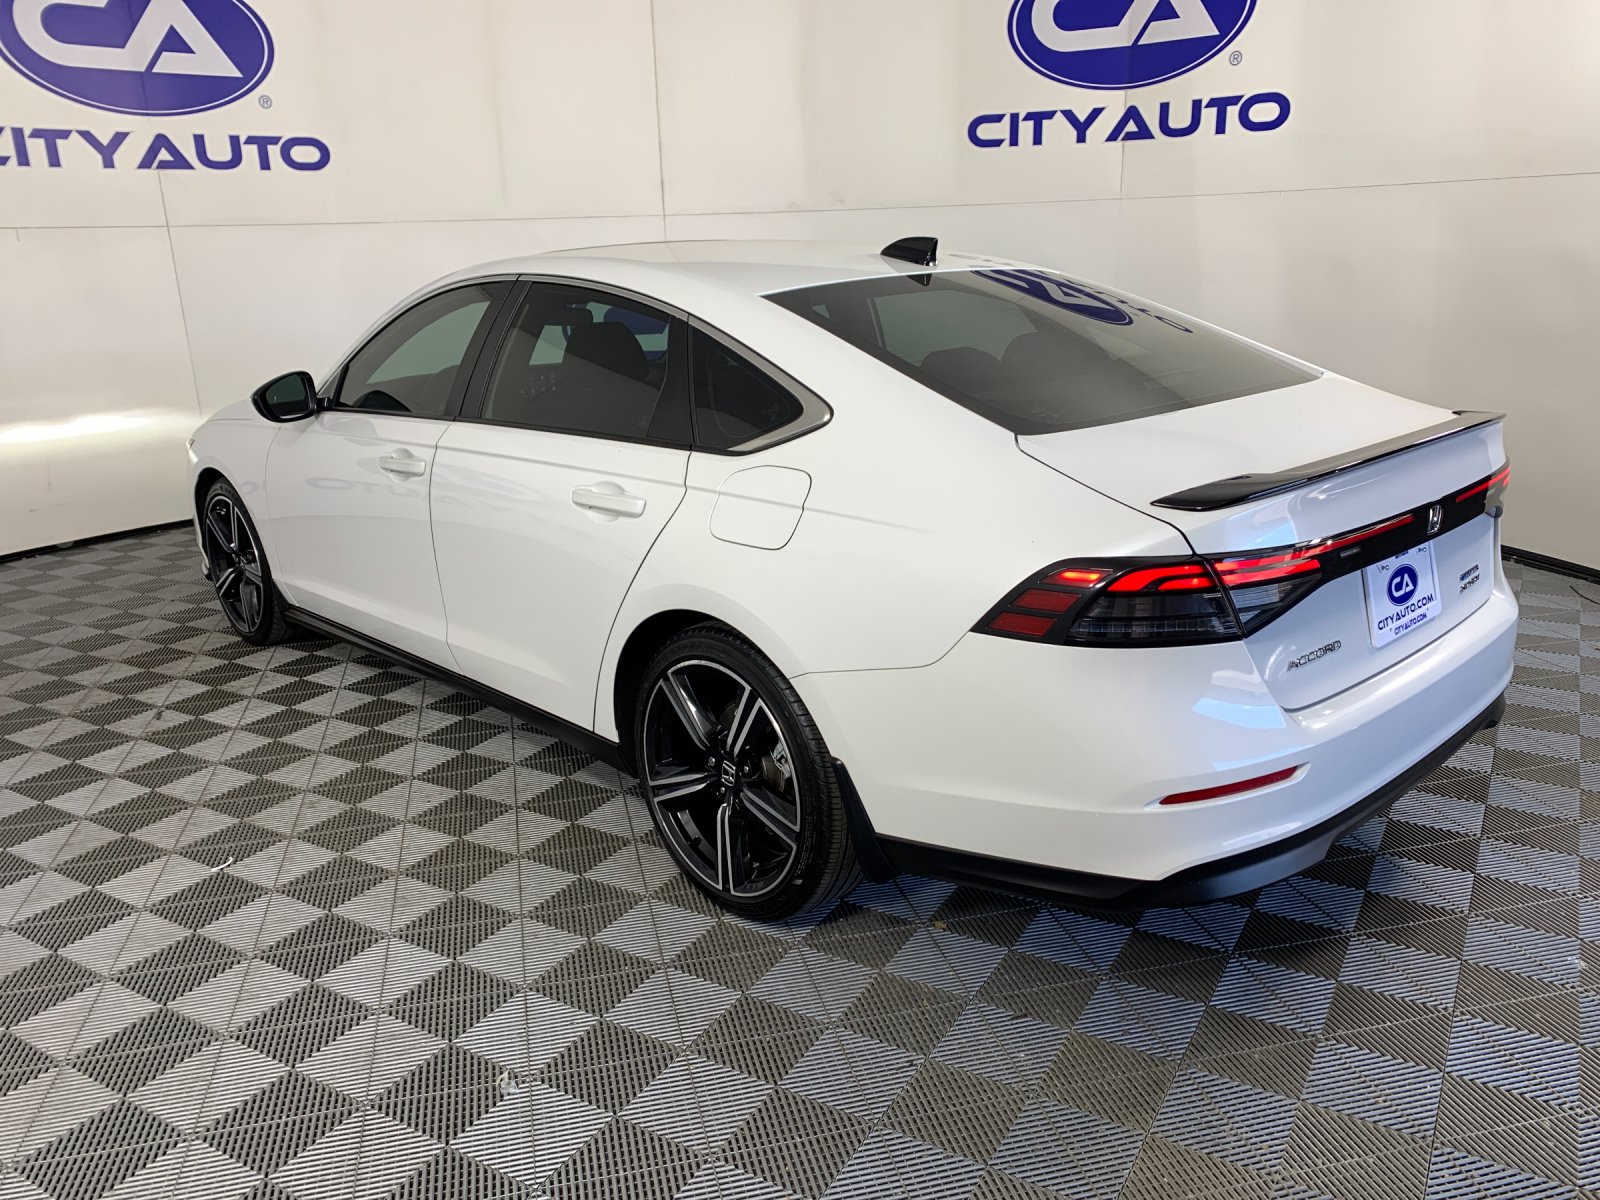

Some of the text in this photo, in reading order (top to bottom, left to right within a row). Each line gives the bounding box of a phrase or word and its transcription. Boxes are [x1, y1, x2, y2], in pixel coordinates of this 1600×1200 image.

[967, 91, 1292, 148] CITY AUTO
[0, 126, 331, 171] ITY AUTO
[1391, 573, 1415, 598] CA
[1377, 593, 1434, 631] CITYAUTO.COM
[1286, 640, 1342, 672] ACCORD
